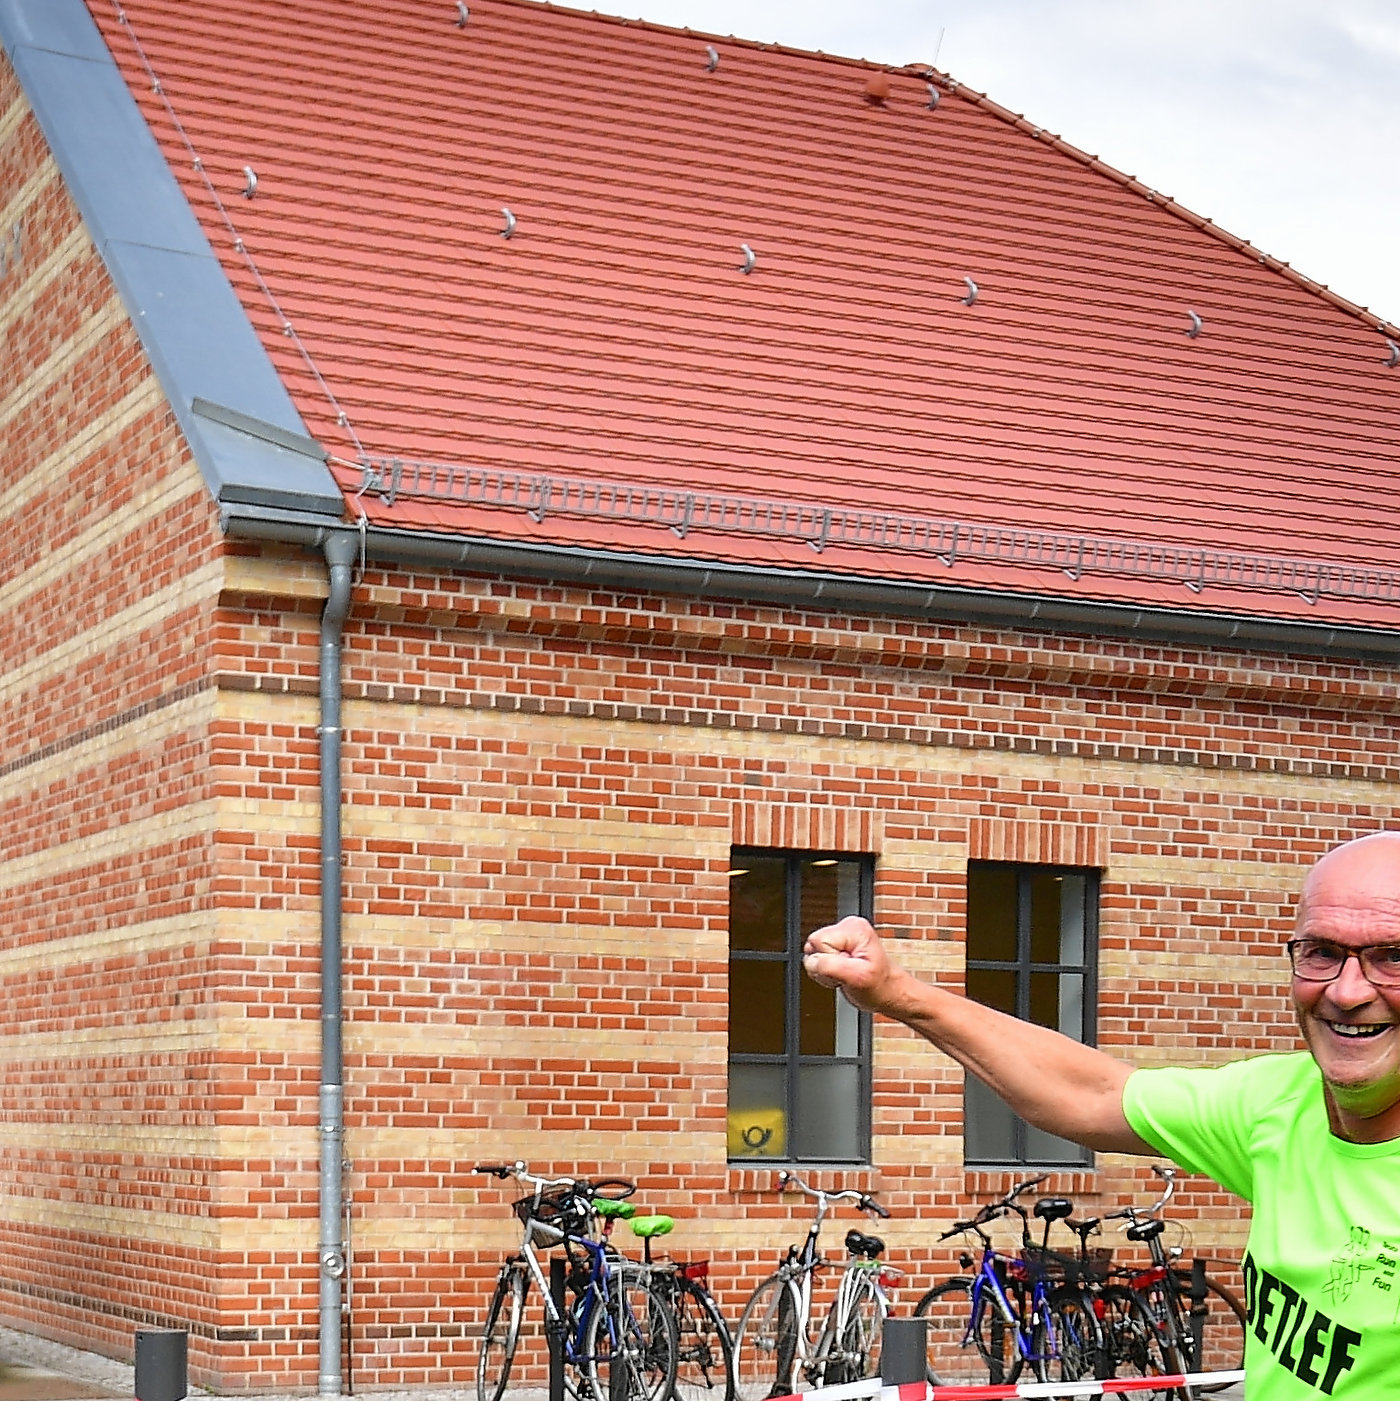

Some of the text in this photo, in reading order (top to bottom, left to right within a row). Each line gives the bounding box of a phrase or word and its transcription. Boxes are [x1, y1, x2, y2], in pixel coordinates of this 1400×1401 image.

[1376, 1253, 1396, 1268] Run
[1372, 1277, 1391, 1291] Fun
[1243, 1250, 1362, 1396] DETLEF
